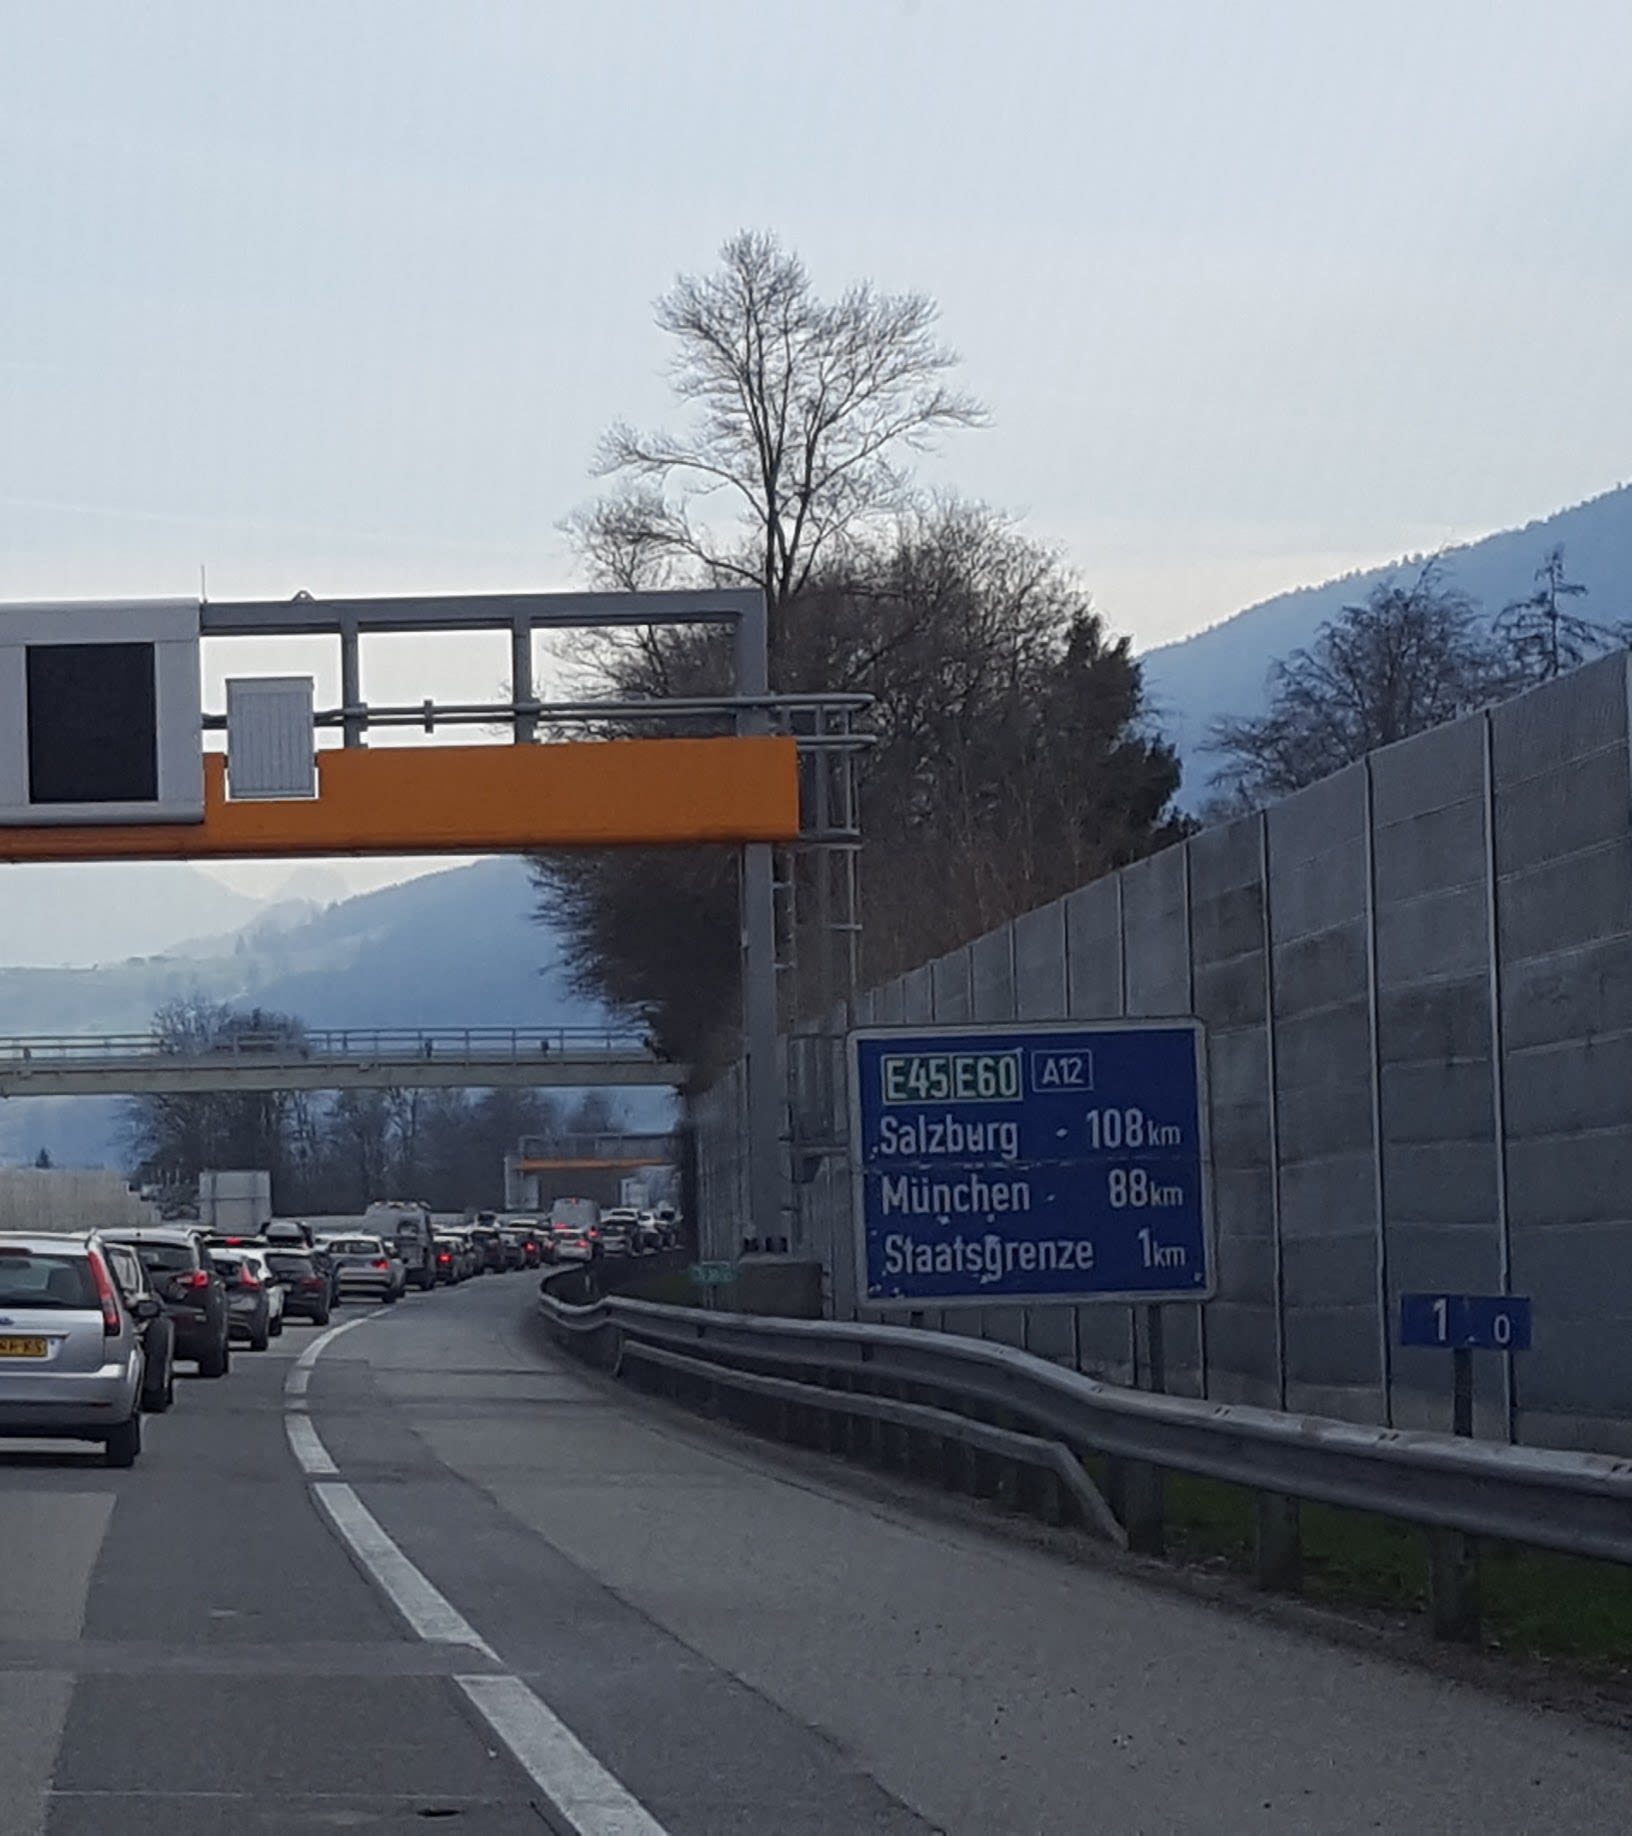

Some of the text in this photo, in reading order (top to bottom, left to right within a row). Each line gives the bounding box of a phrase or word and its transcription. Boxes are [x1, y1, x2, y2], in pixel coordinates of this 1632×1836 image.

[886, 1056, 1017, 1099] E45 E60
[1041, 1057, 1085, 1085] A12
[880, 1114, 1018, 1160] Salzburg
[881, 1173, 1031, 1215] München
[884, 1234, 1095, 1282] Staatsgrenze
